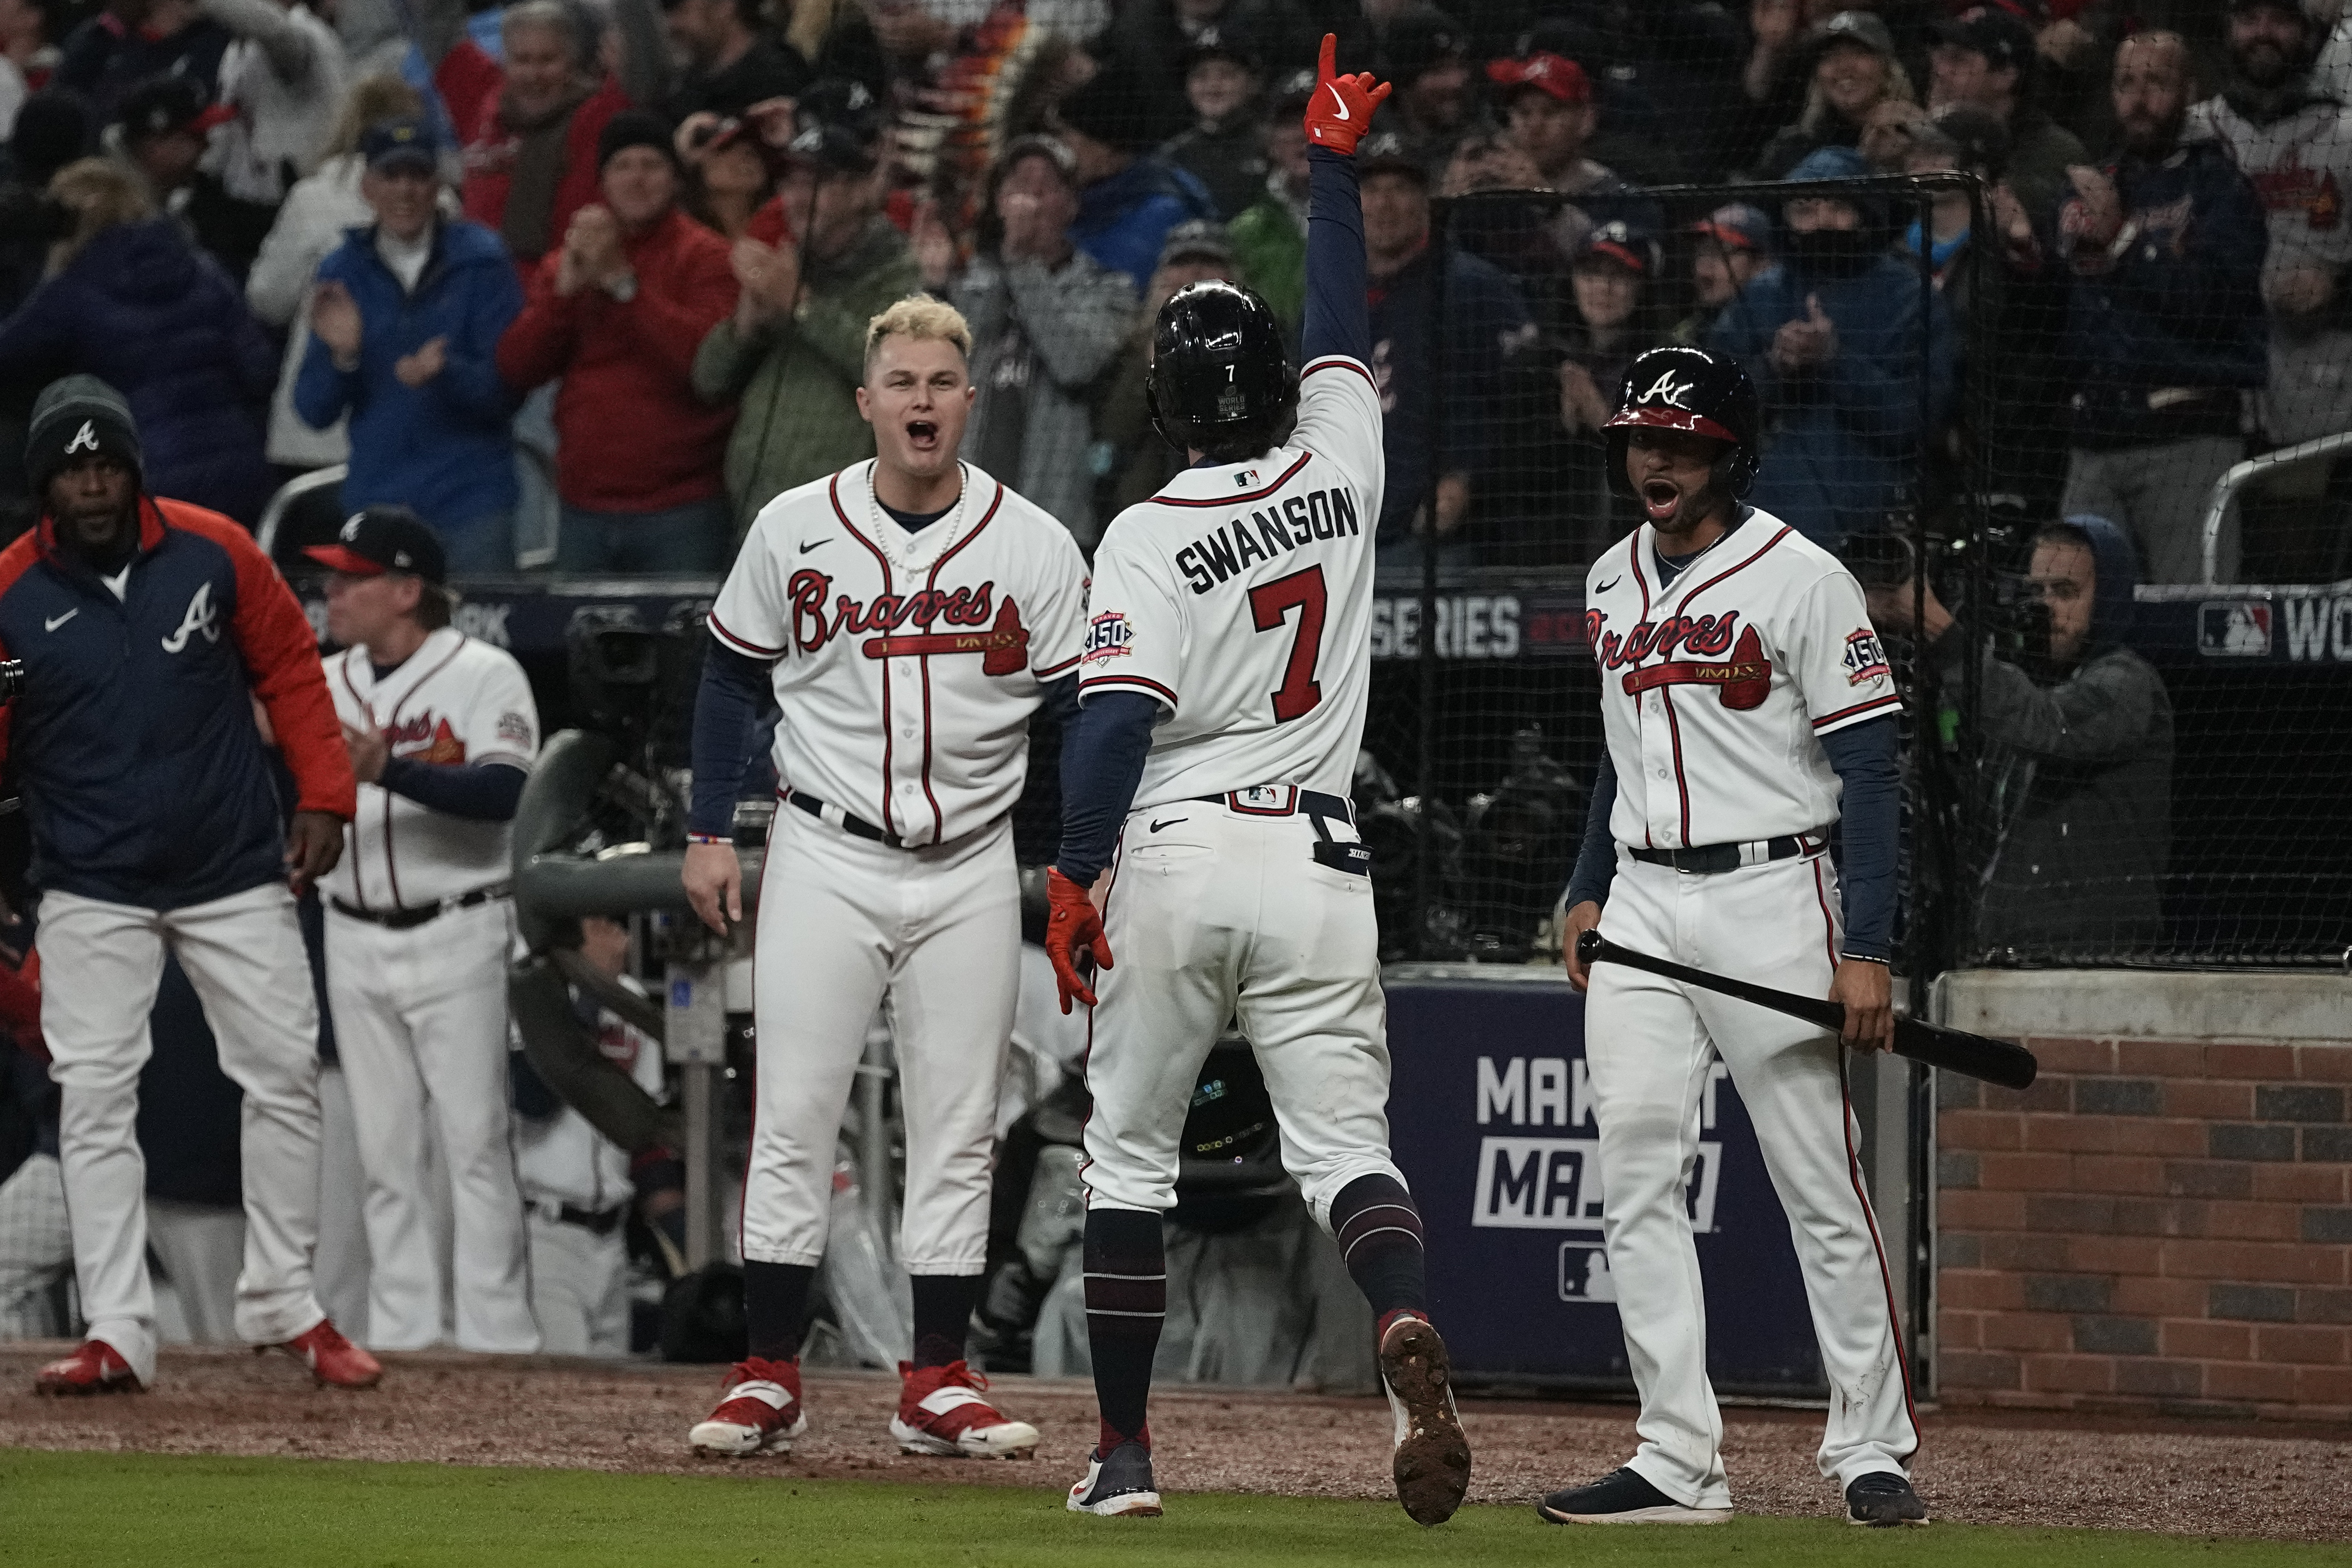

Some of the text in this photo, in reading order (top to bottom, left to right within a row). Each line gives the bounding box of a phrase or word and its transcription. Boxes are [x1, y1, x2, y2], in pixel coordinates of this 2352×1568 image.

[1225, 365, 1235, 382] 7
[1637, 369, 1677, 405] A
[1218, 396, 1245, 405] WORLD
[1219, 402, 1246, 412] SERIES
[64, 419, 100, 455] A
[1176, 487, 1359, 595] SWANSON
[161, 580, 220, 653] A
[788, 568, 994, 658] Braves
[1095, 614, 1121, 622] BRAVES
[1088, 620, 1126, 652] 150
[1091, 649, 1118, 659] ANNIVERSARY
[1247, 563, 1327, 725] 7
[1847, 638, 1885, 672] 150
[1477, 1057, 1601, 1126] MAK
[1487, 1149, 1706, 1221] MAR
